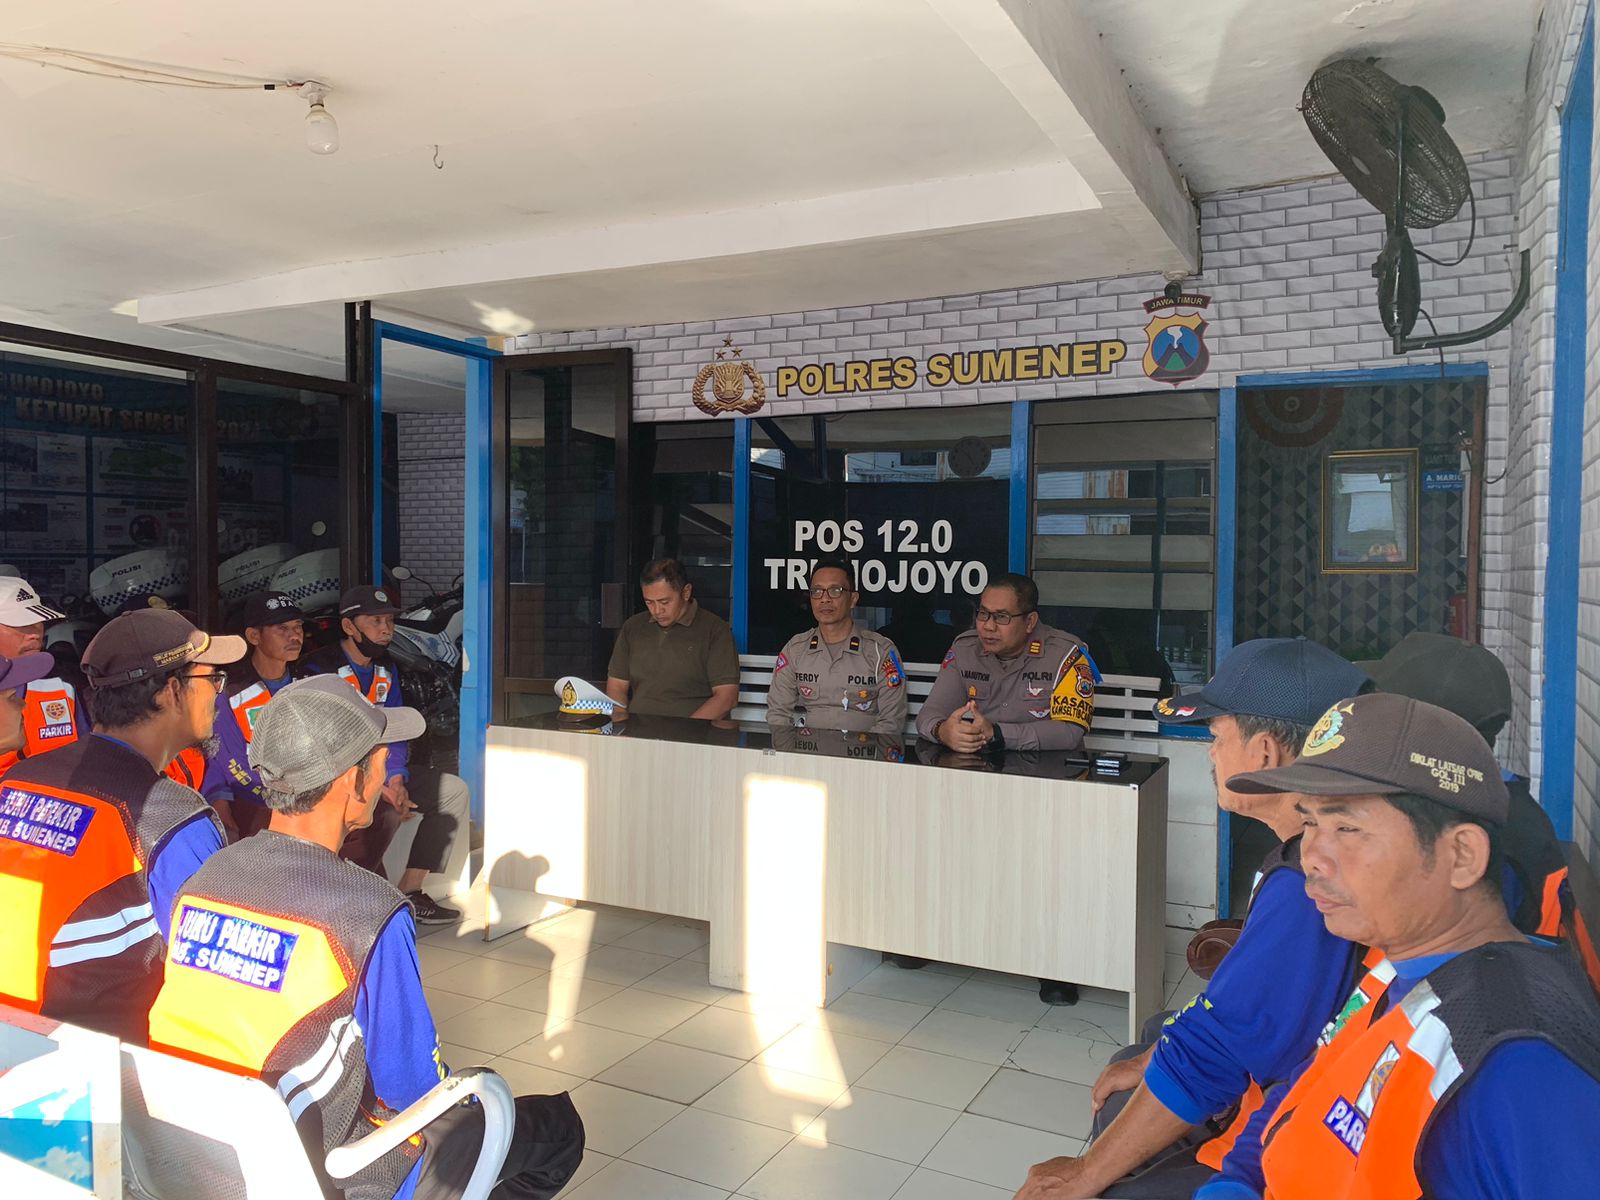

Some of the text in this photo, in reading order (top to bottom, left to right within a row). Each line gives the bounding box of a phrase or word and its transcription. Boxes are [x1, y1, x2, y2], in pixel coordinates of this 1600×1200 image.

[1151, 296, 1203, 309] JAWA TIMUR
[776, 340, 1127, 397] POLRES SUMENEP
[795, 519, 953, 553] POS 12.0
[111, 564, 142, 578] POLISI
[235, 559, 261, 573] POLISI
[277, 568, 297, 579] POLISI
[764, 558, 988, 595] TROJOYO
[847, 675, 877, 685] POLRI
[1022, 671, 1053, 681] POLRI
[39, 724, 72, 738] PARKIR
[1439, 779, 1460, 793] 2019
[29, 797, 83, 832] PARKIR
[217, 919, 281, 964] PARKIR
[195, 947, 281, 988] SUMENEP
